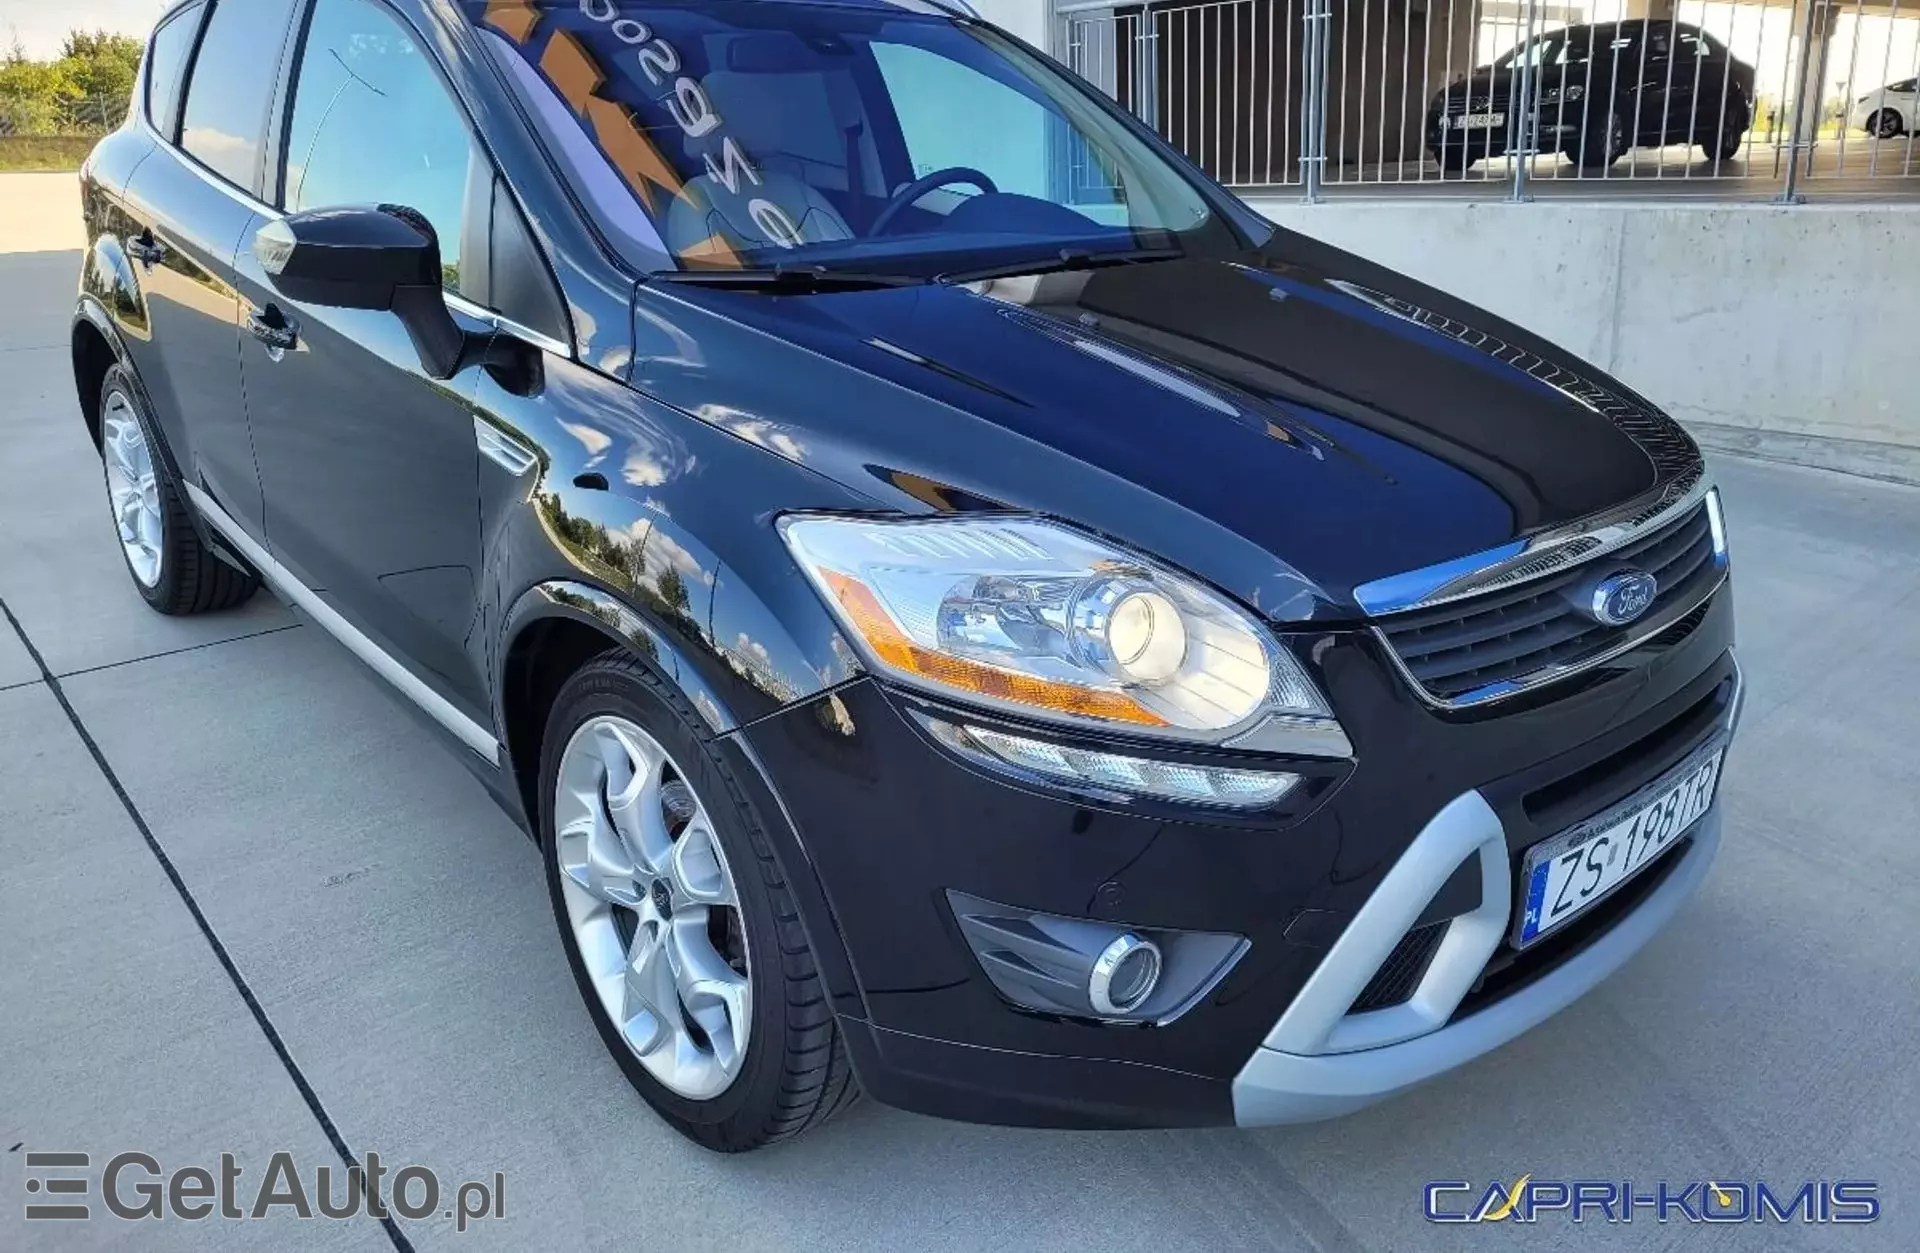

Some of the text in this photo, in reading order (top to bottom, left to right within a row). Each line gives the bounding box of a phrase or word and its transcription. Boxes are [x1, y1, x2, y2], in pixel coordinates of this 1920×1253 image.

[1618, 584, 1648, 615] Ford
[1550, 837, 1609, 918] ZS
[1622, 761, 1713, 871] 198TR
